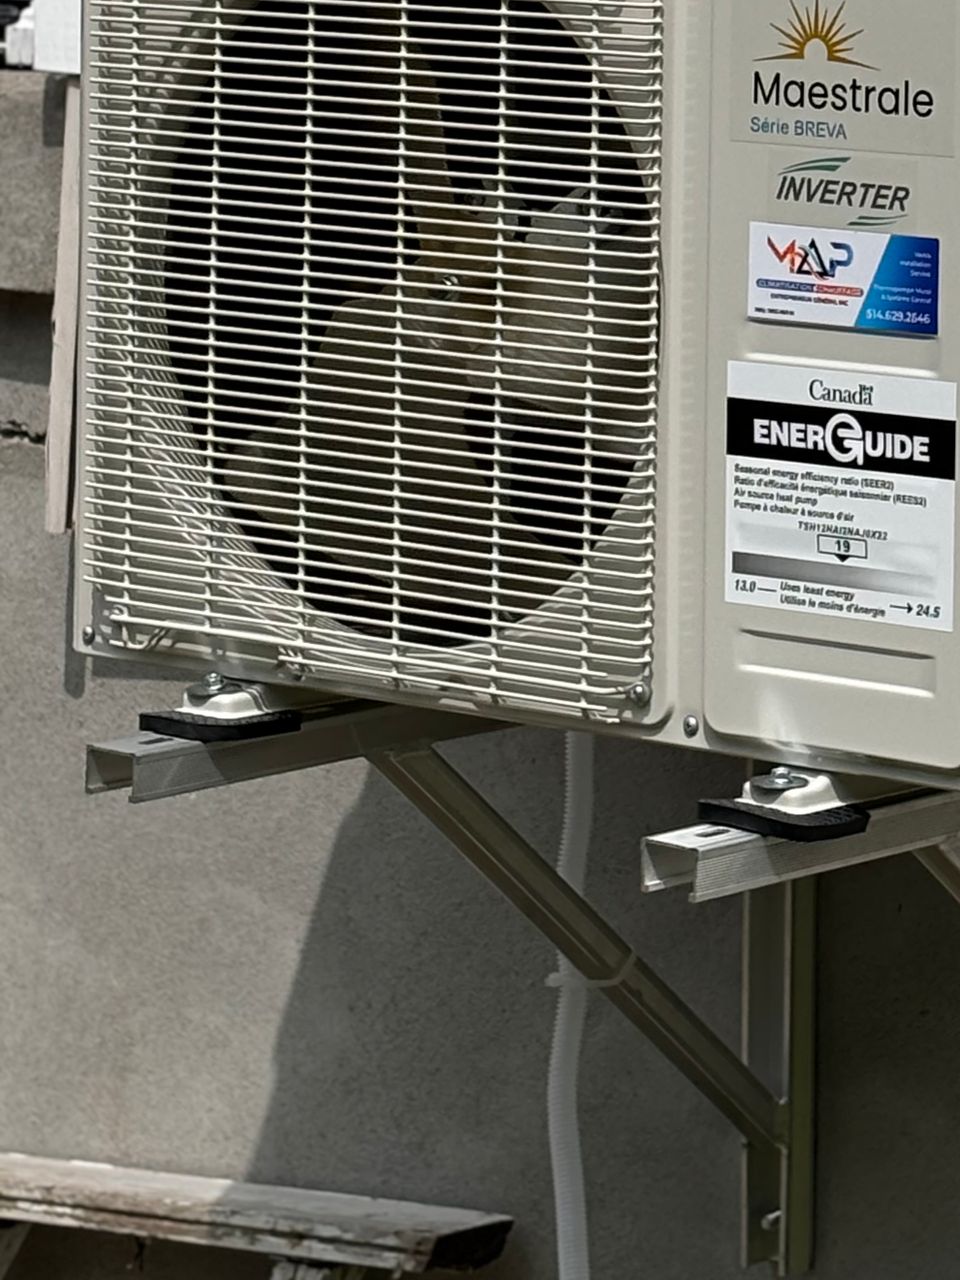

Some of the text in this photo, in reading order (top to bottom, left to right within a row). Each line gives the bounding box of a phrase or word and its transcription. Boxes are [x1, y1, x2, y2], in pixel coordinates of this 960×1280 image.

[753, 71, 934, 117] Maestrale
[750, 117, 847, 140] Série BREVA
[776, 176, 910, 211] INVERTER
[809, 379, 874, 406] Canada
[753, 413, 930, 466] ENERGUIDE
[734, 463, 771, 475] Seasonal
[772, 470, 799, 481] energy
[800, 471, 839, 485] efficiency
[861, 478, 895, 491] (SEER2)
[734, 487, 818, 507] Air source heat pump
[807, 510, 835, 520] source
[835, 539, 851, 553] 19
[735, 579, 855, 602] 13.0 Uses least energy
[779, 593, 807, 606] Utilise
[808, 598, 816, 608] le
[818, 600, 844, 612] moins
[916, 603, 941, 618] 24.5
